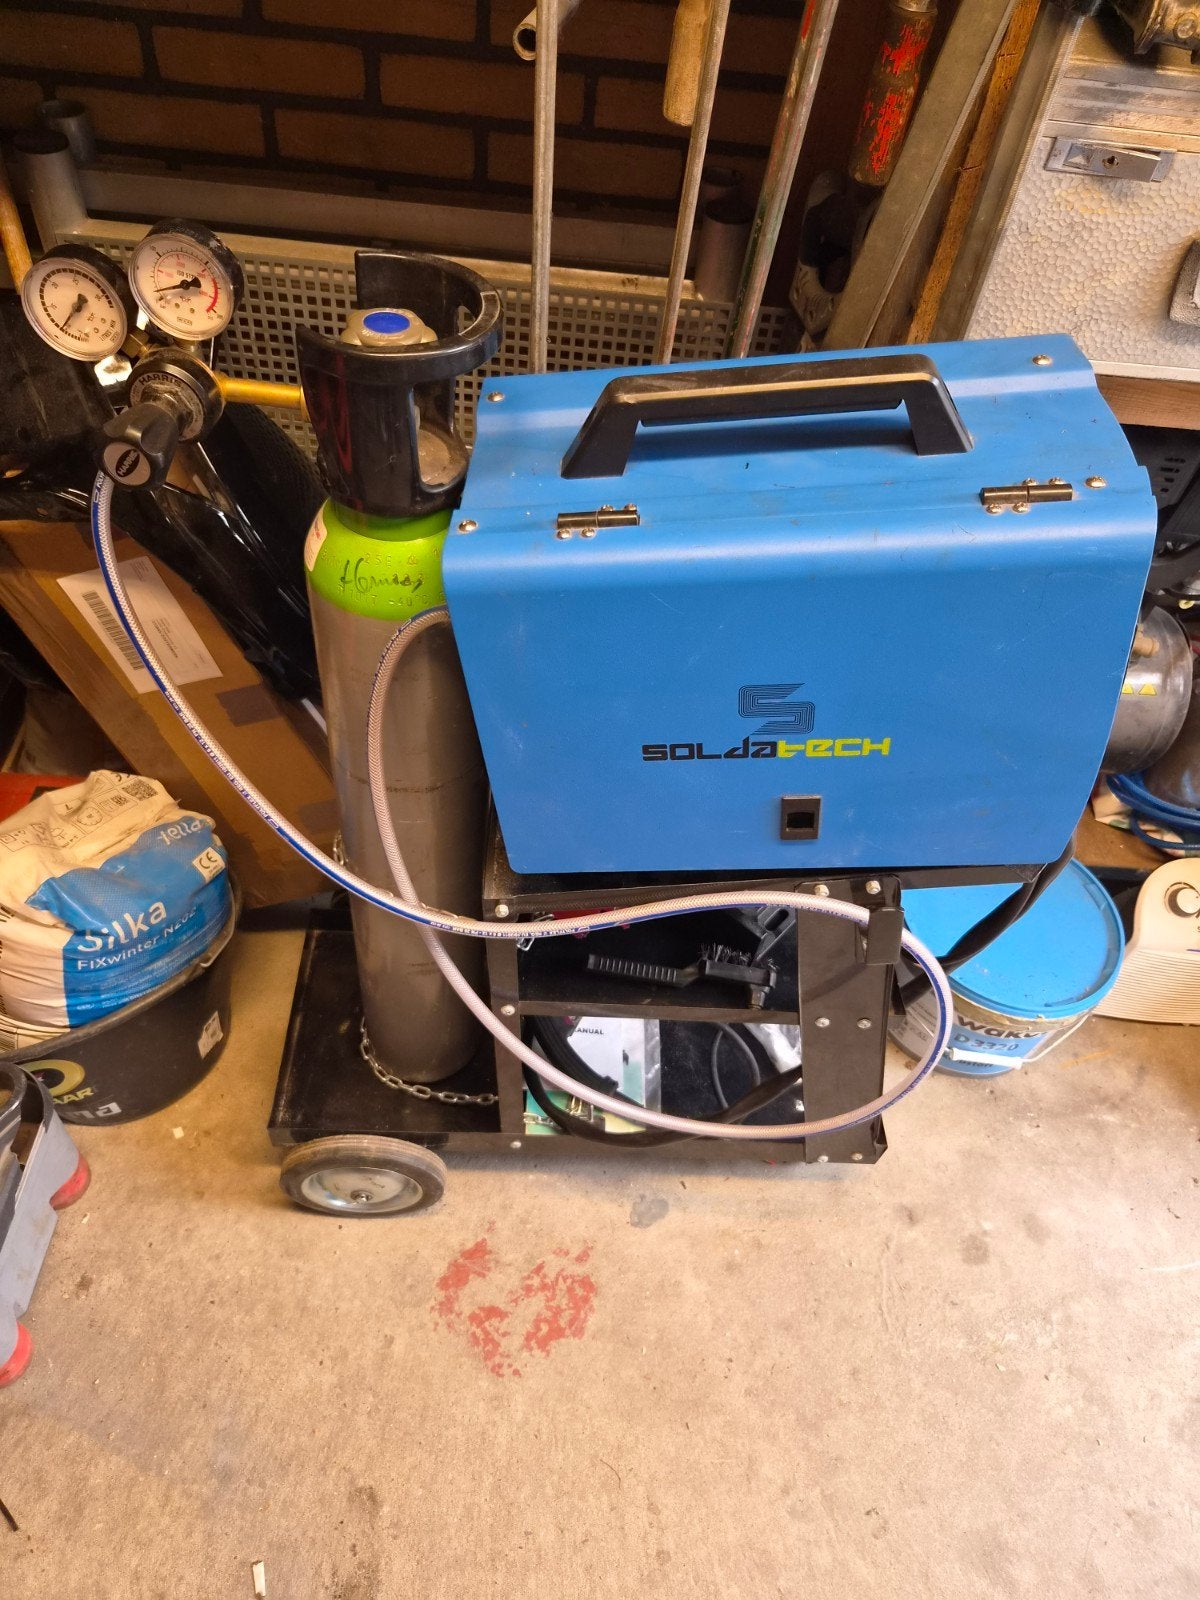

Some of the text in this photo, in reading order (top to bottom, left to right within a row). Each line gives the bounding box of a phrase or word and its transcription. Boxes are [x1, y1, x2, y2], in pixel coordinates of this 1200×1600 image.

[139, 373, 184, 386] HARRIS
[117, 450, 139, 476] HARRIS
[77, 901, 167, 952] Silka
